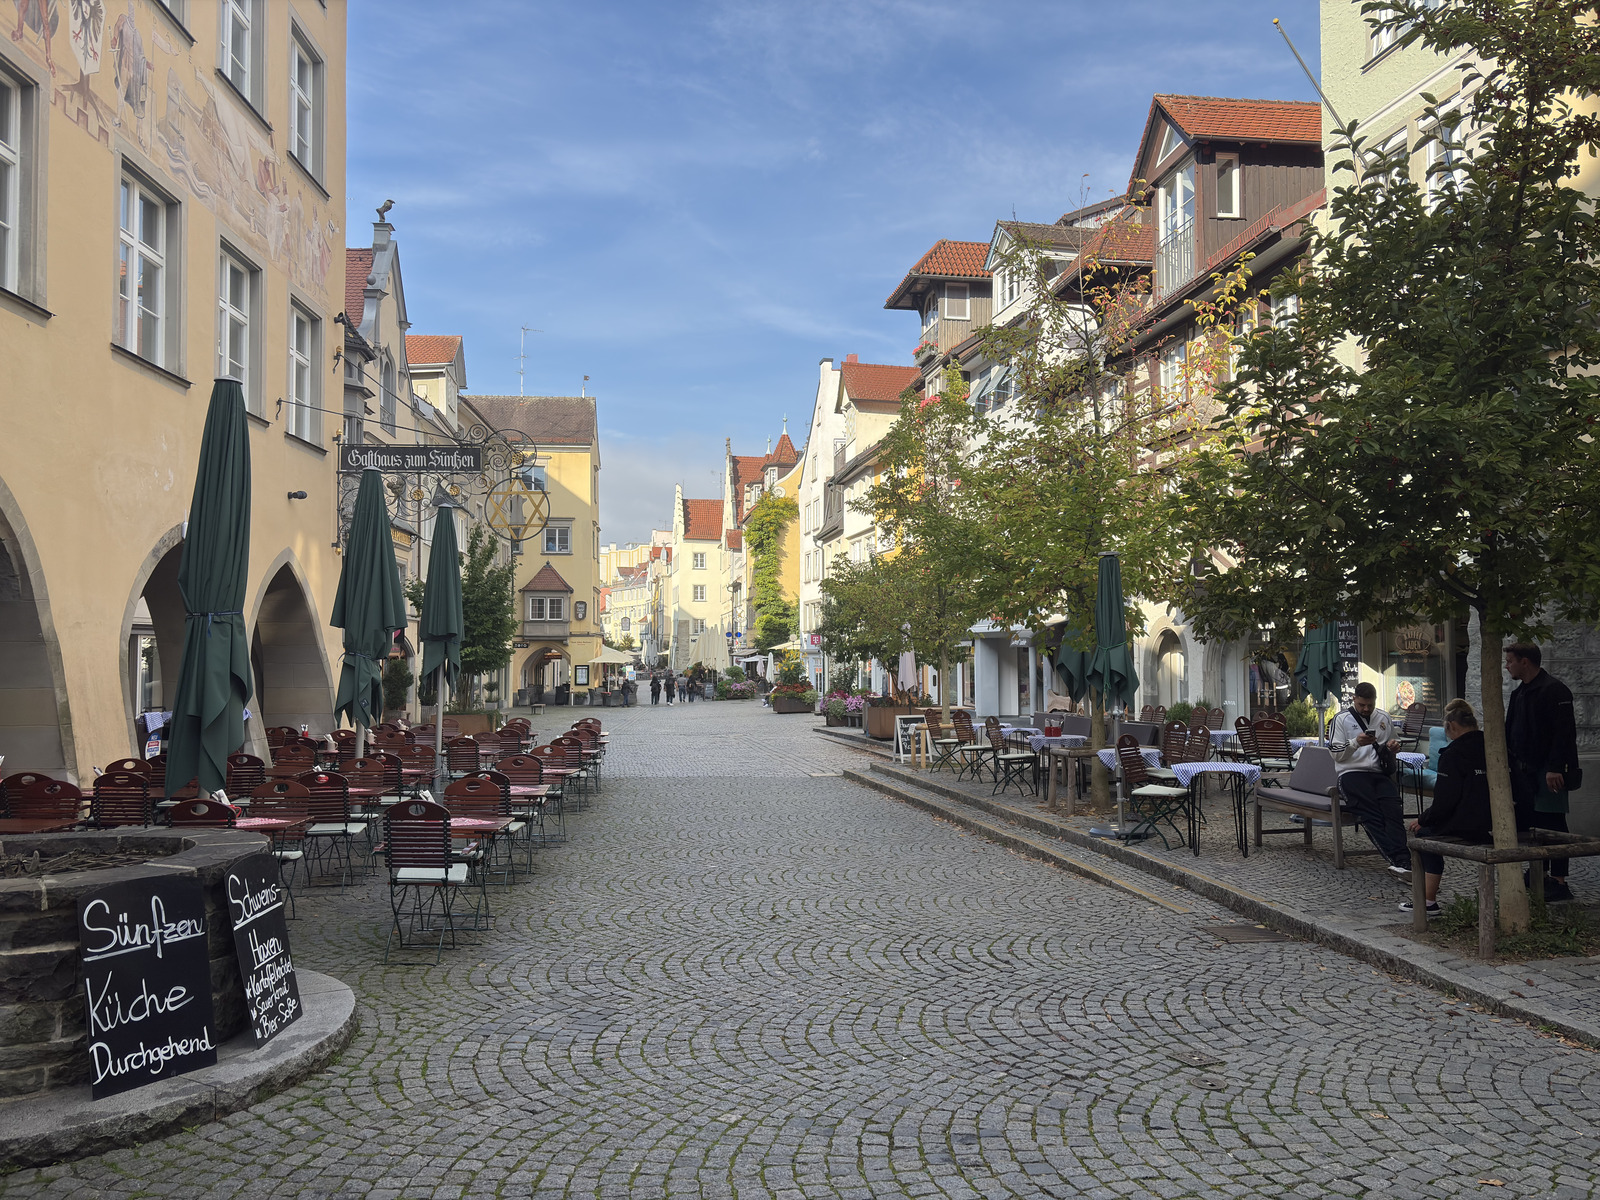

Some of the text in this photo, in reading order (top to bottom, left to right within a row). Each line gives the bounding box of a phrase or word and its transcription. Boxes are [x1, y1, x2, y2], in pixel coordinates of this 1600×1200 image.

[404, 454, 427, 469] zum
[83, 895, 203, 958] Sünfzen
[249, 929, 282, 967] Haxen
[85, 970, 194, 1036] Küche
[89, 1025, 216, 1085] Durchgehend
